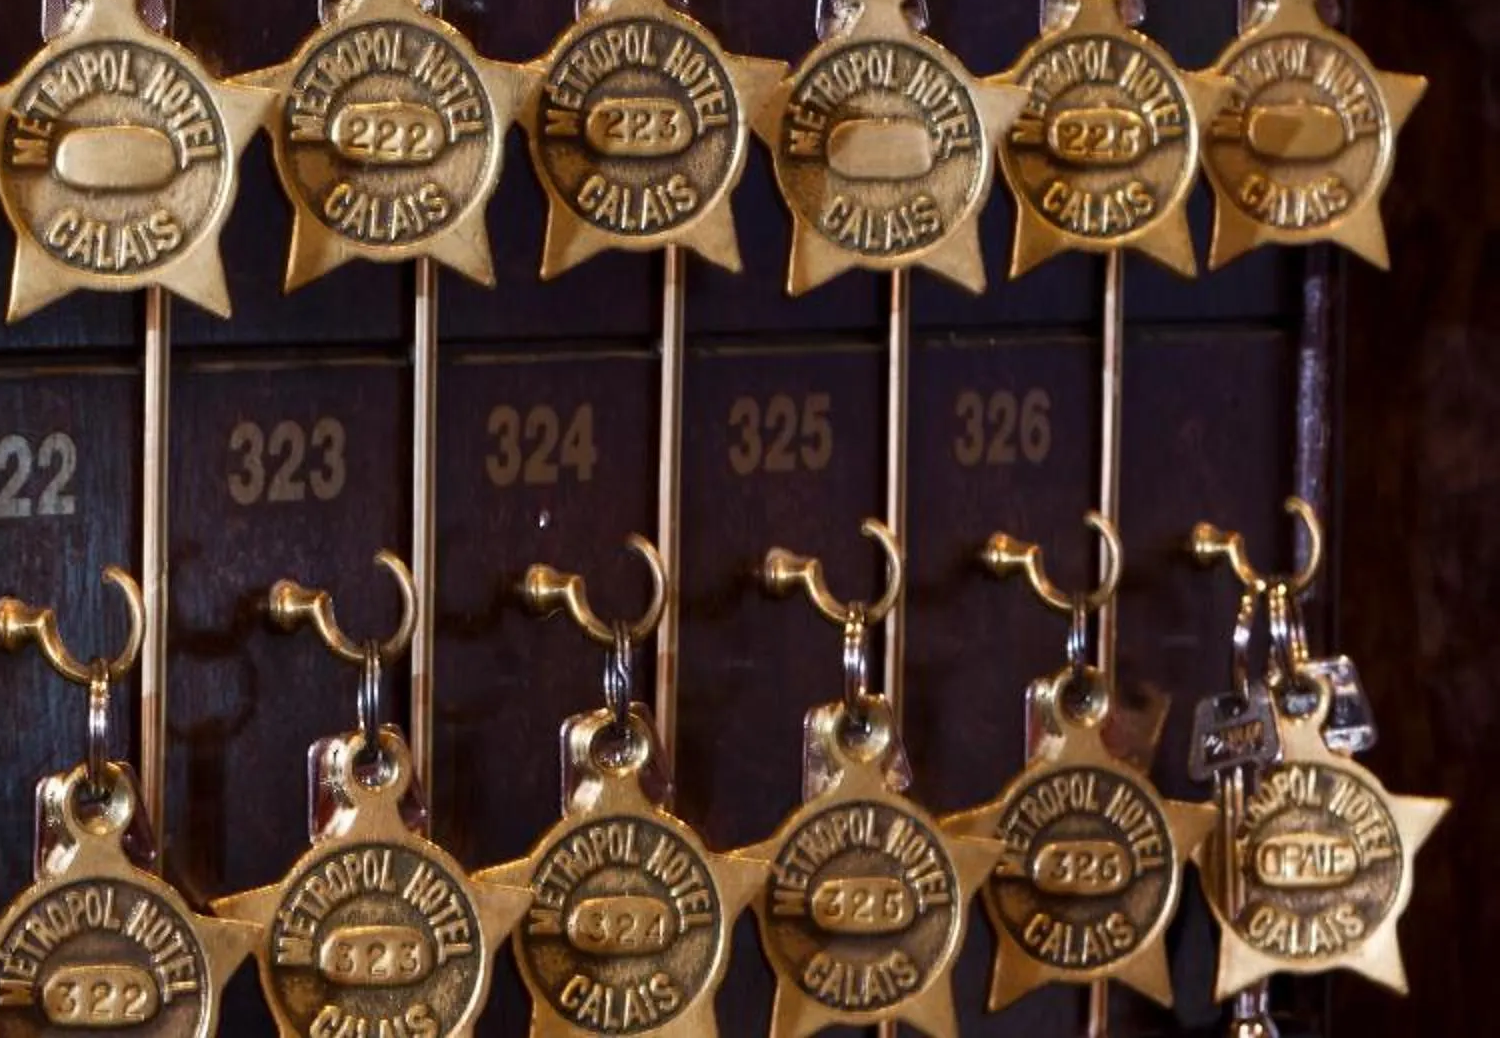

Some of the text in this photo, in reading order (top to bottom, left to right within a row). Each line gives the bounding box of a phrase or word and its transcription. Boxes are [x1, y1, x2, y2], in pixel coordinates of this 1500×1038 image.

[142, 60, 217, 168] HOTEL
[413, 40, 484, 143] HOTEL
[662, 36, 730, 135] HOTEL
[906, 59, 973, 158] HOTEL
[1120, 52, 1183, 145] HOTEL
[347, 117, 434, 158] 222
[598, 109, 674, 140] 223
[323, 181, 450, 239] CALAIS
[576, 172, 698, 229] CALAIS
[820, 194, 941, 249] CALAIS
[1042, 179, 1154, 231] CALAIS
[1239, 172, 1348, 224] CALAIS
[46, 208, 181, 268] CALAIS
[485, 402, 596, 487] 324
[728, 392, 833, 475] 325
[954, 387, 1051, 466] 326
[228, 417, 346, 505] 323
[1104, 783, 1165, 876] HOTEL
[645, 834, 713, 934] HOTEL
[885, 817, 949, 913] HOTEL
[1050, 850, 1121, 884] 326
[402, 861, 473, 964] HOTEL
[587, 912, 664, 944] 324
[823, 886, 902, 921] 325
[1247, 902, 1365, 954] CALAIS
[126, 897, 198, 1003] HOTEL
[334, 942, 421, 976] 323
[1023, 911, 1134, 963] CALAIS
[55, 980, 146, 1020] 322
[559, 971, 680, 1028] CALAIS
[802, 950, 918, 1005] CALAIS
